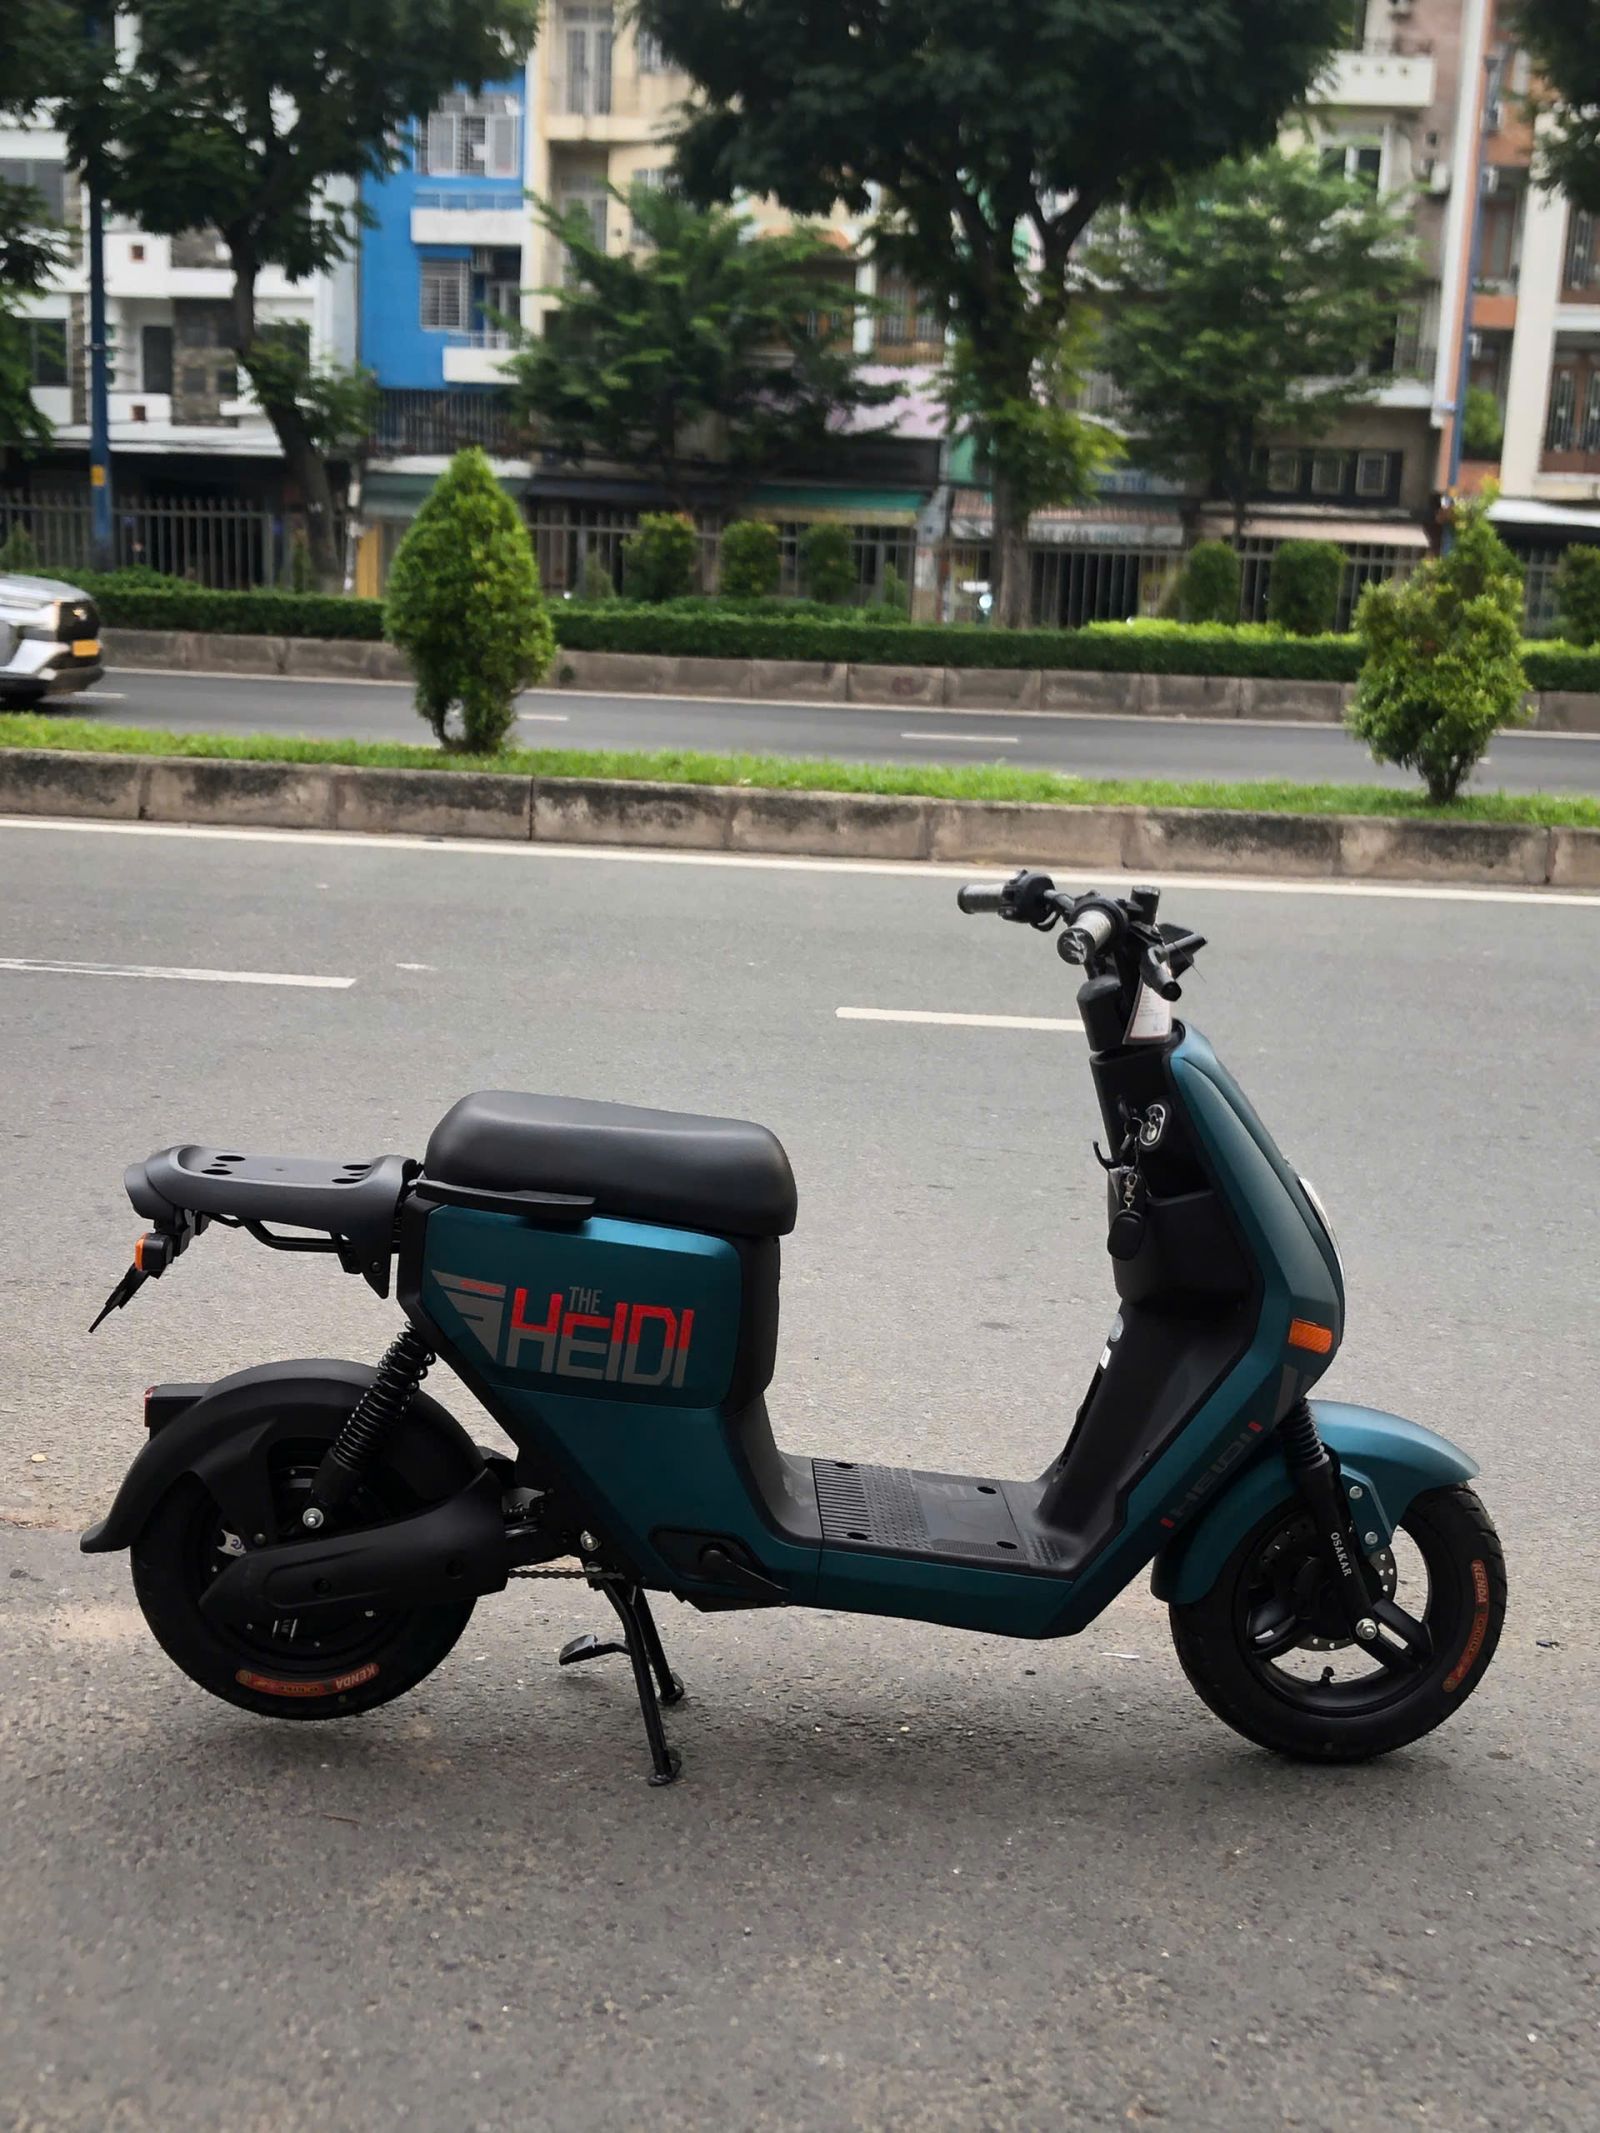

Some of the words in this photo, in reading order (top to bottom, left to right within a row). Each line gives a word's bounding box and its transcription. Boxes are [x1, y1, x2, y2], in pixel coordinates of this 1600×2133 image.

[569, 1286, 603, 1315] THE
[506, 1288, 694, 1388] HEIDI
[1330, 1532, 1352, 1577] OSAKAR
[1472, 1563, 1488, 1604] KENDA
[336, 1665, 376, 1689] KENDA
